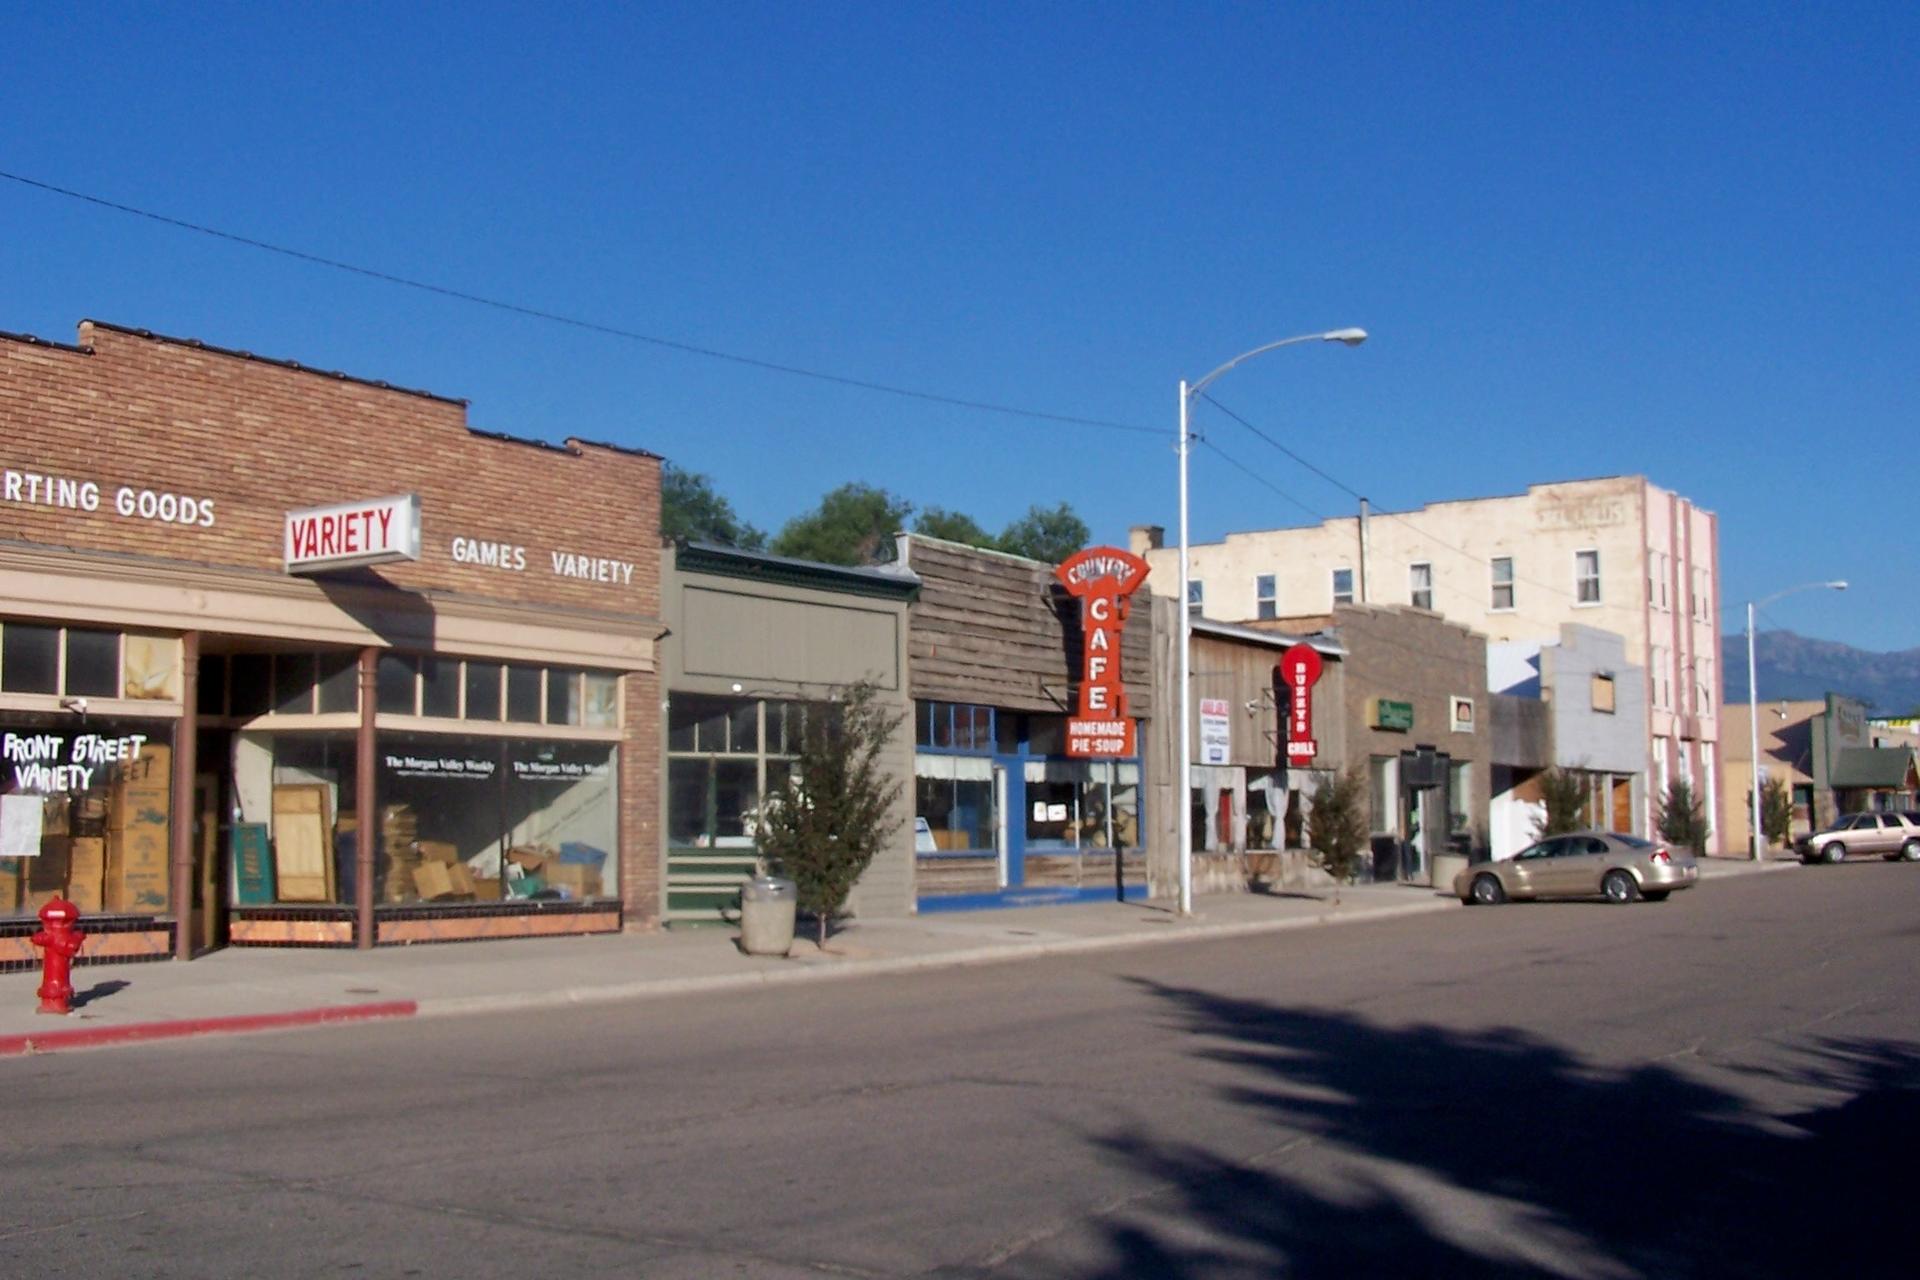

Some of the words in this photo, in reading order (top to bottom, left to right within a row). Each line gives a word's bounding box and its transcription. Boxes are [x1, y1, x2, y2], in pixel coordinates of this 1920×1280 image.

[5, 470, 100, 512] RTING
[116, 487, 216, 527] GOODS
[291, 507, 393, 560] VARIETY
[452, 536, 527, 571] GAMES
[551, 550, 635, 585] VARIETY
[1089, 598, 1108, 710] CAFE
[1070, 721, 1126, 737] HOMEMADE
[4, 733, 64, 763] FRONT
[72, 734, 147, 764] STREET
[1072, 738, 1090, 752] PIE
[15, 764, 95, 793] VARIETY
[386, 756, 404, 768] The
[404, 757, 439, 771] Morgan
[439, 758, 464, 772] Valley
[513, 761, 529, 773] The
